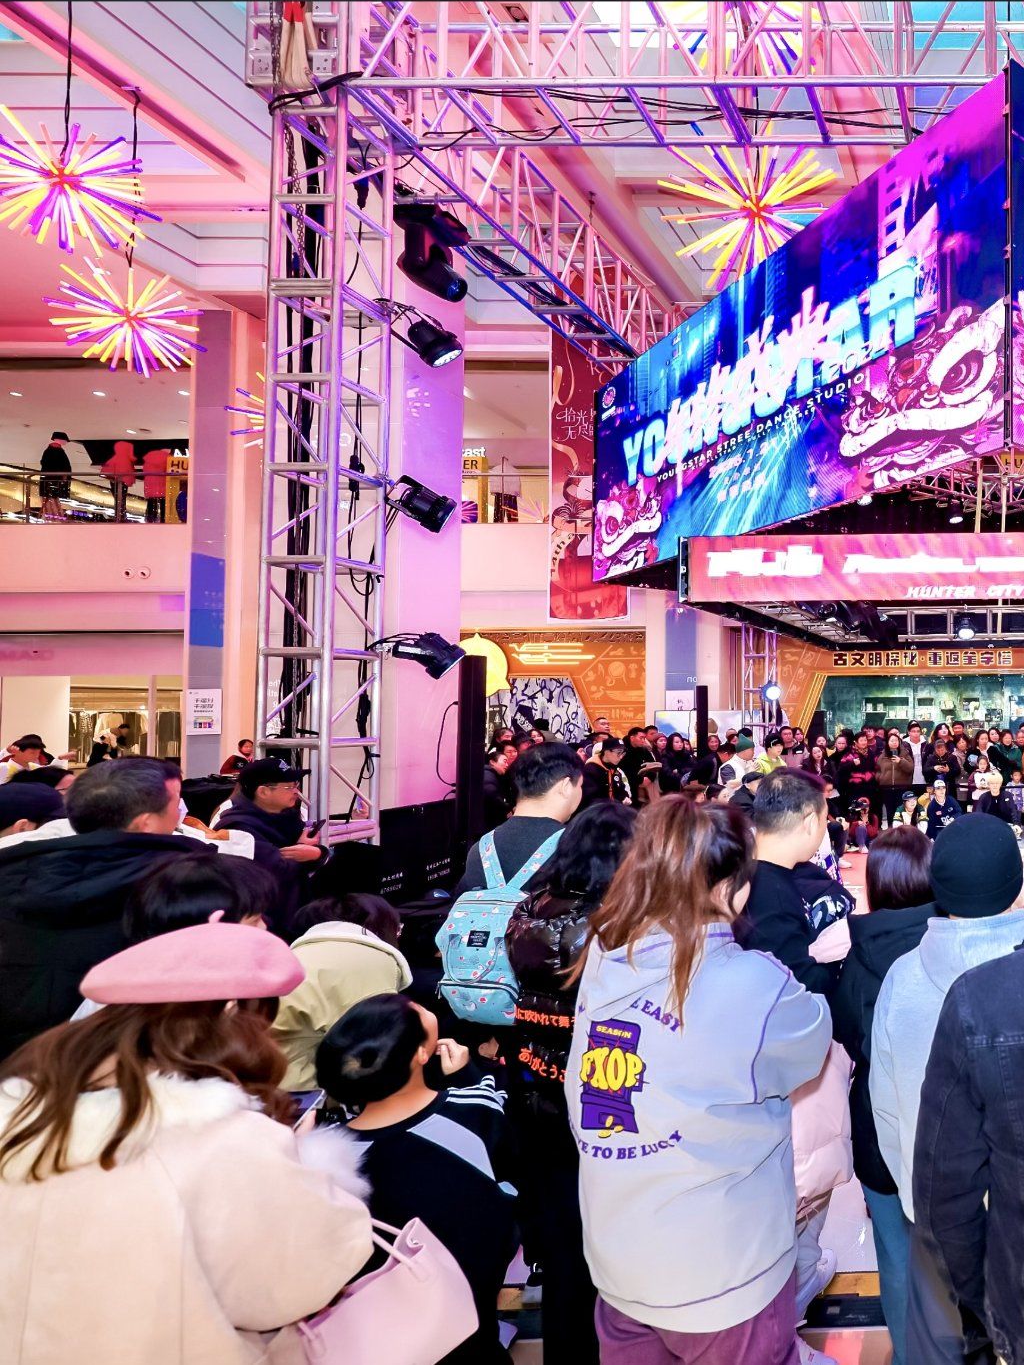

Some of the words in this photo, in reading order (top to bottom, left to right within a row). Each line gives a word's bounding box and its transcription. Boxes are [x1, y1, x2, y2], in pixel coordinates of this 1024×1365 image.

[716, 429, 752, 454] STREE
[756, 404, 801, 434] DANCE
[806, 372, 865, 408] STUDIO
[906, 585, 976, 598] HUNTER
[596, 1024, 632, 1039] SEASON
[592, 1145, 613, 1160] TO
[616, 1146, 637, 1160] BE
